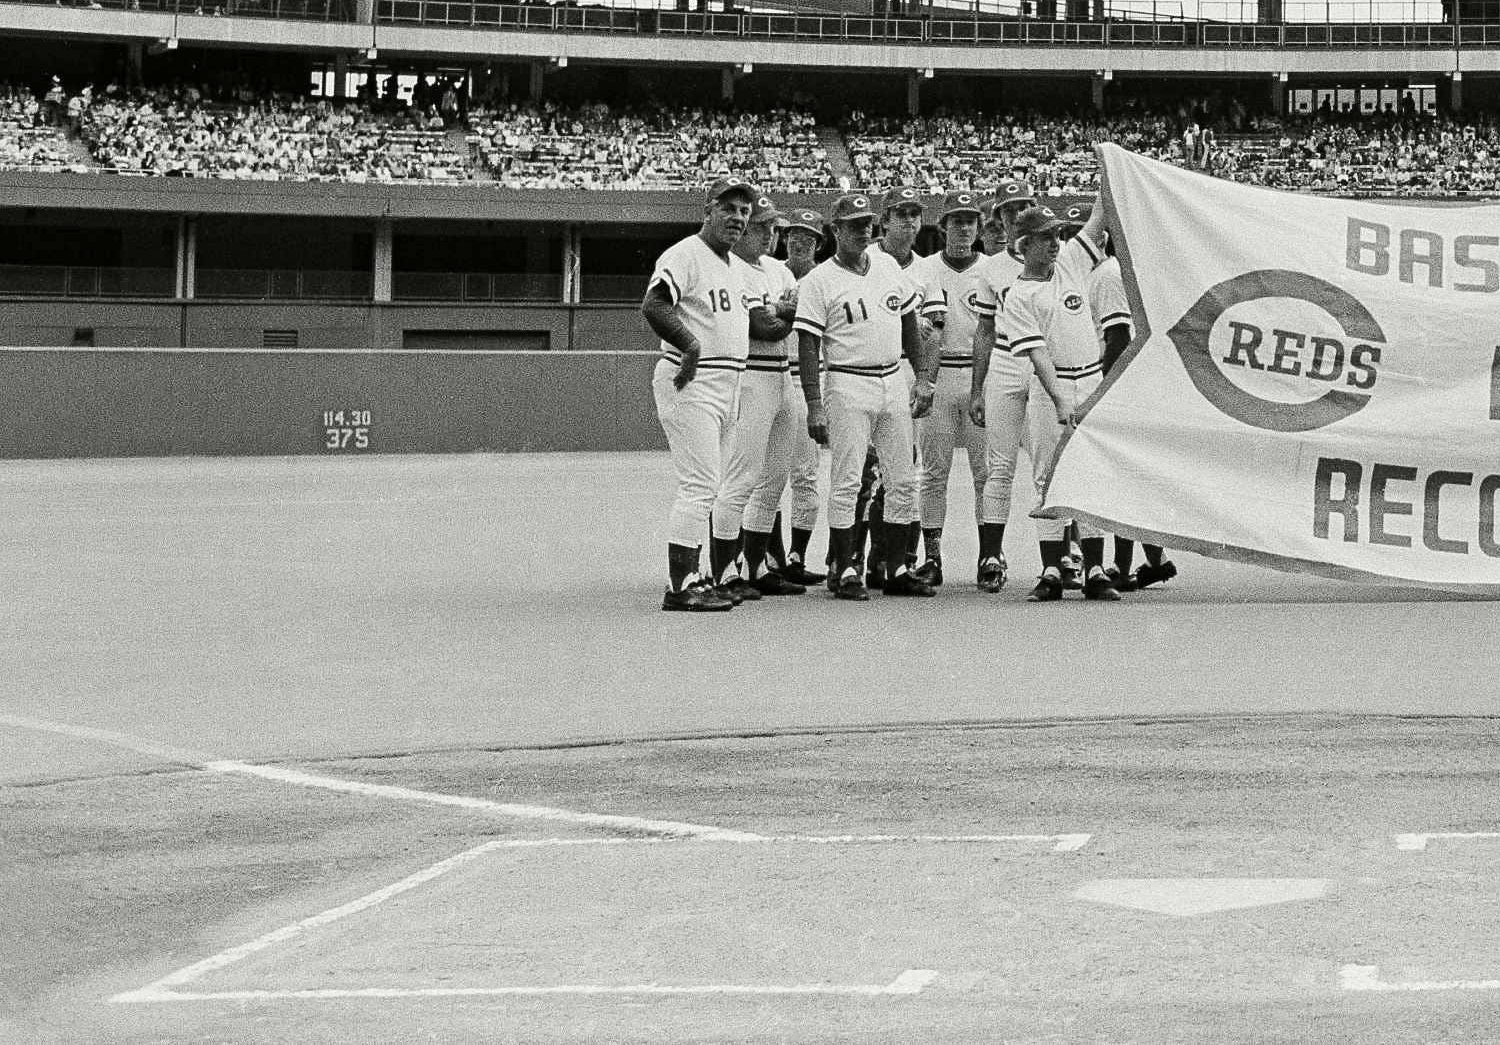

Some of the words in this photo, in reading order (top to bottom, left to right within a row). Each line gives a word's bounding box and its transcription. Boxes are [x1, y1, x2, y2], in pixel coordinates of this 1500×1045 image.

[958, 194, 971, 204] C
[1067, 207, 1081, 218] C
[708, 288, 732, 313] 18
[842, 297, 869, 324] 11
[1222, 320, 1382, 390] REDS
[323, 410, 371, 426] 114.30
[326, 428, 369, 448] 375
